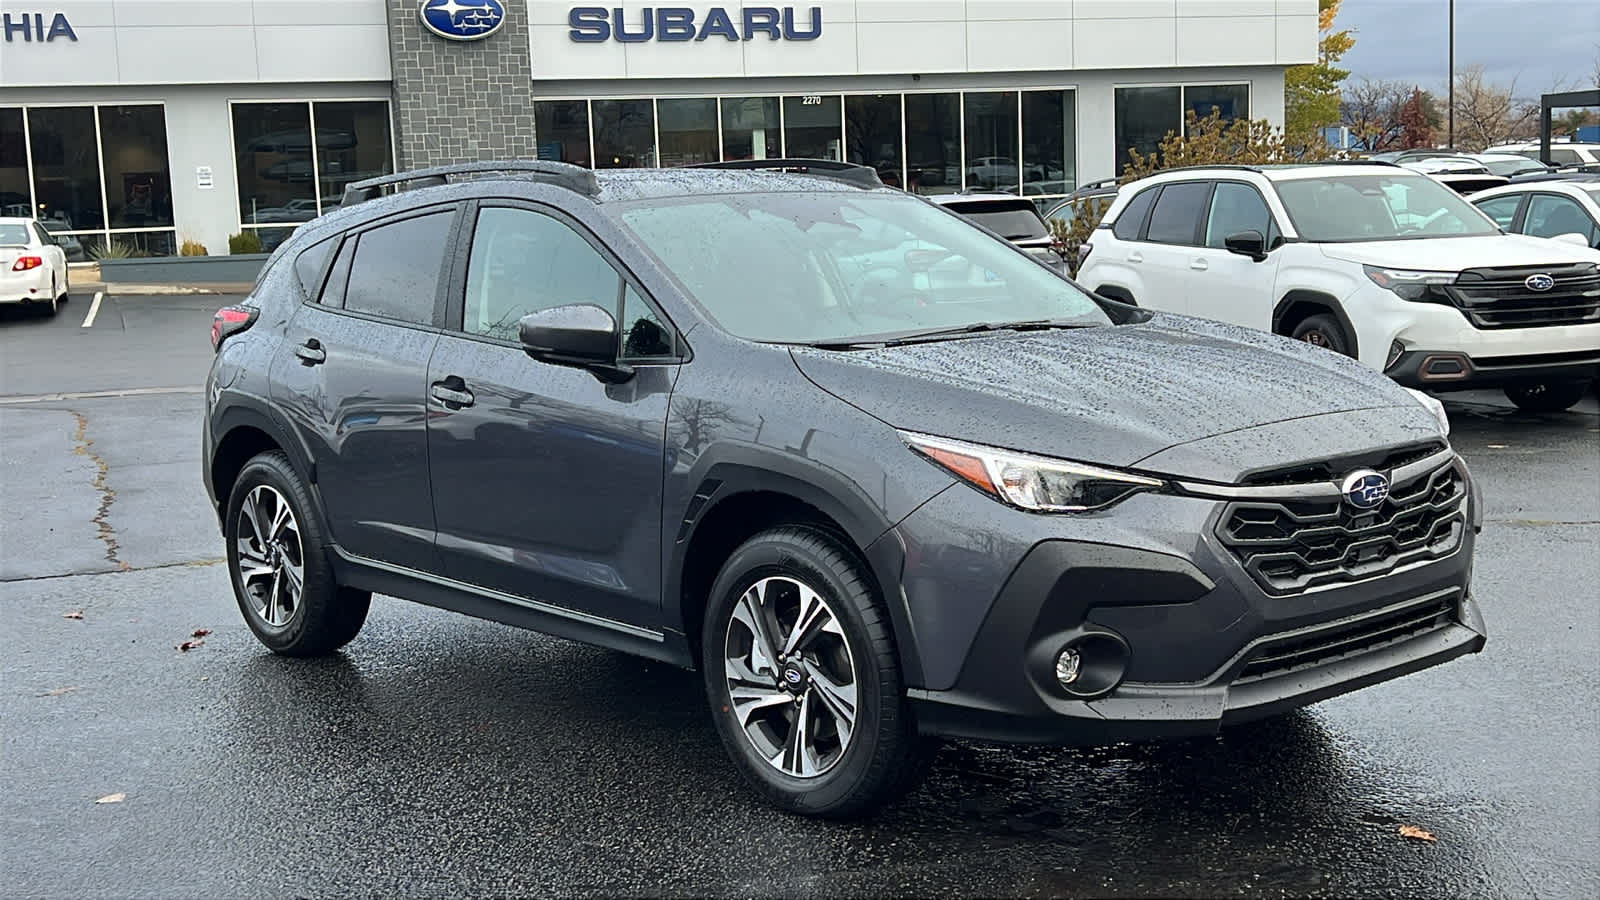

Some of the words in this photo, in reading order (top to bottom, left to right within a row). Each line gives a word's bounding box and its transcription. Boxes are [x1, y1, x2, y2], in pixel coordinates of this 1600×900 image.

[3, 13, 78, 42] HIA
[569, 7, 822, 42] SUBARU
[802, 96, 822, 105] 2270
